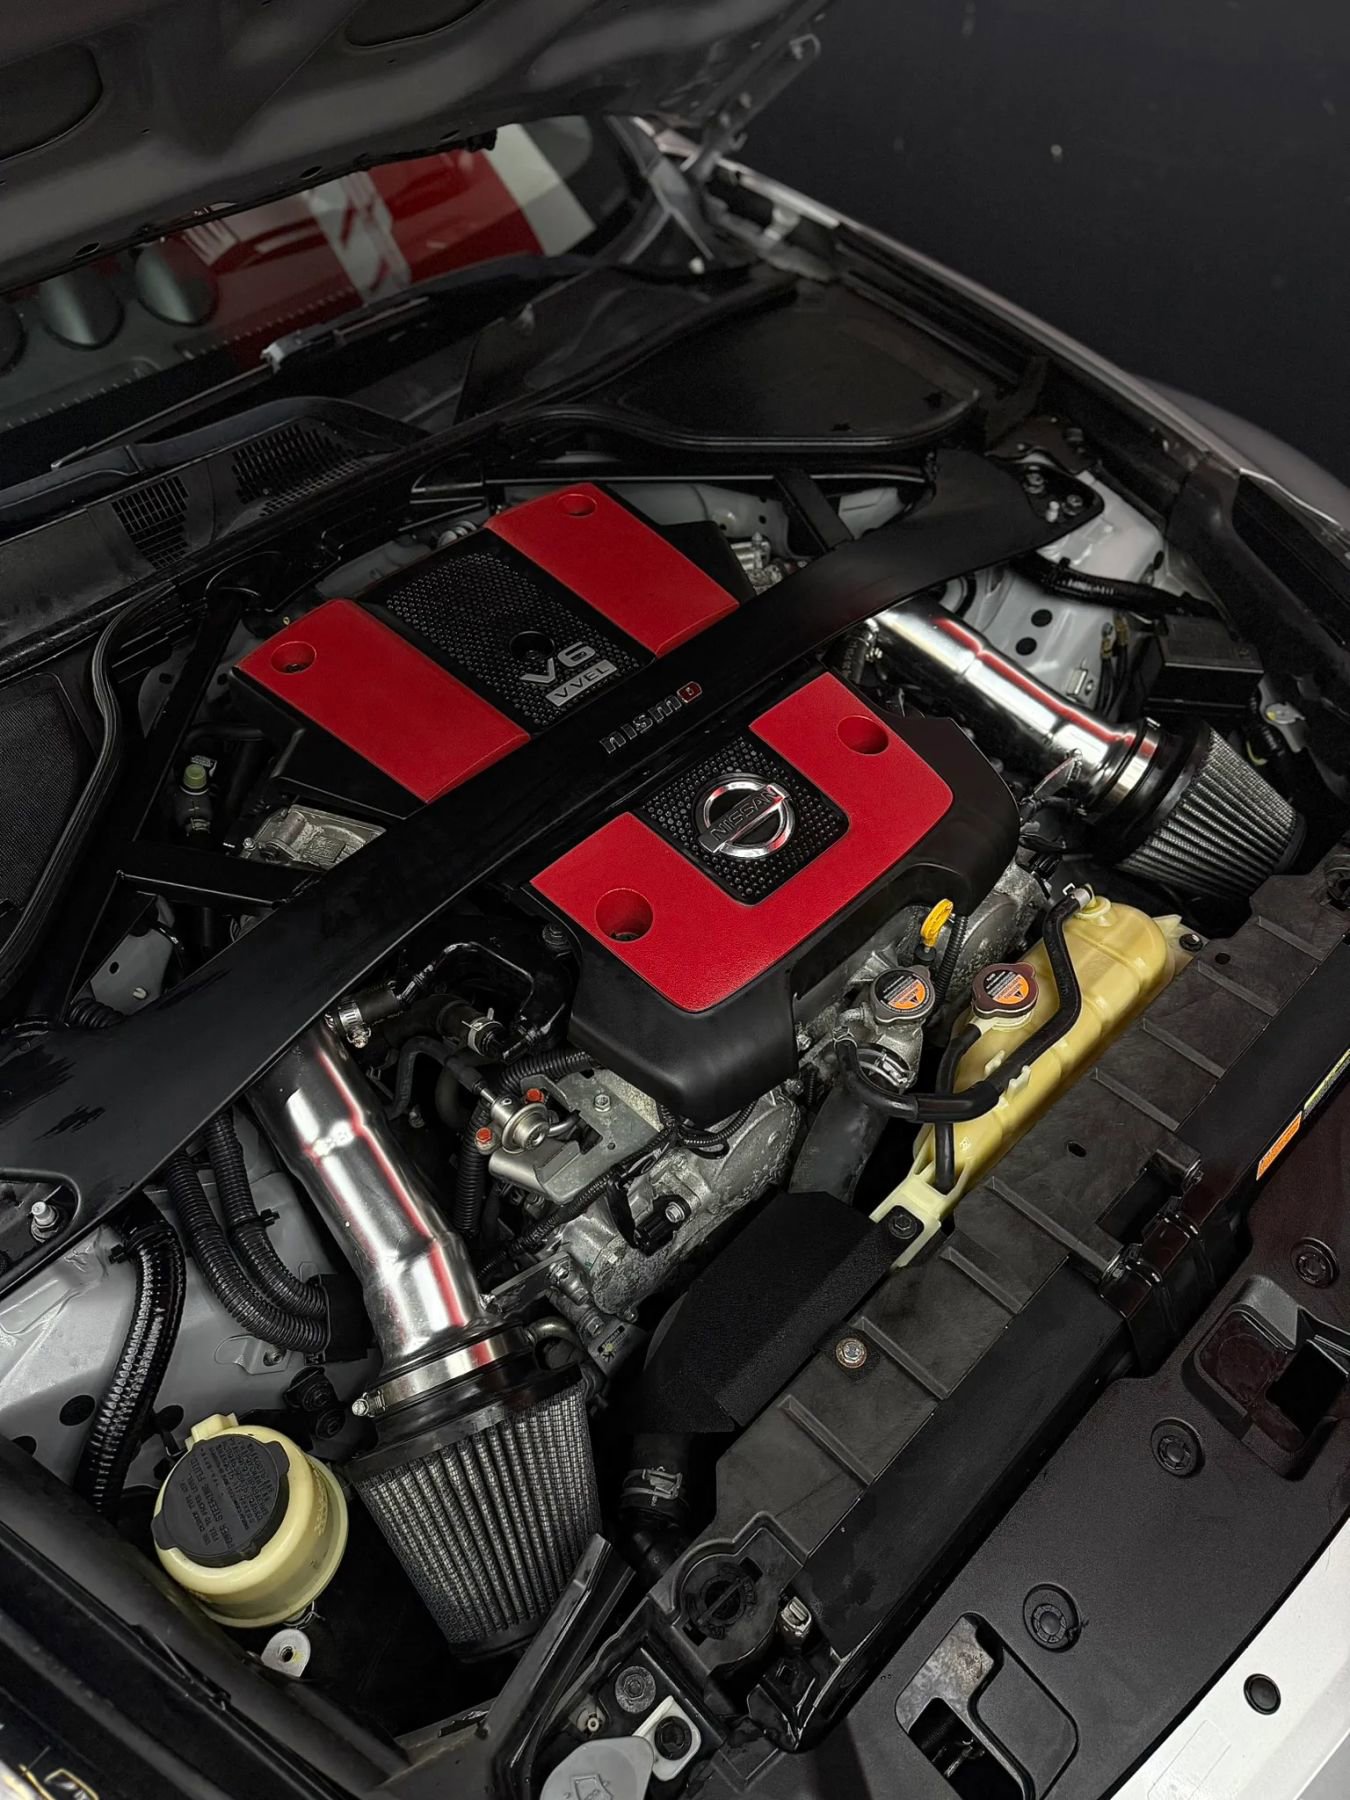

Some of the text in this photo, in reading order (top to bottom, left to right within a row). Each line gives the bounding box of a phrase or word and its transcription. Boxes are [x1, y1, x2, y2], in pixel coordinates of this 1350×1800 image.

[520, 641, 596, 684] V6
[554, 665, 610, 698] VVEL
[710, 790, 779, 841] NISSAN
[190, 1457, 206, 1481] FLUID
